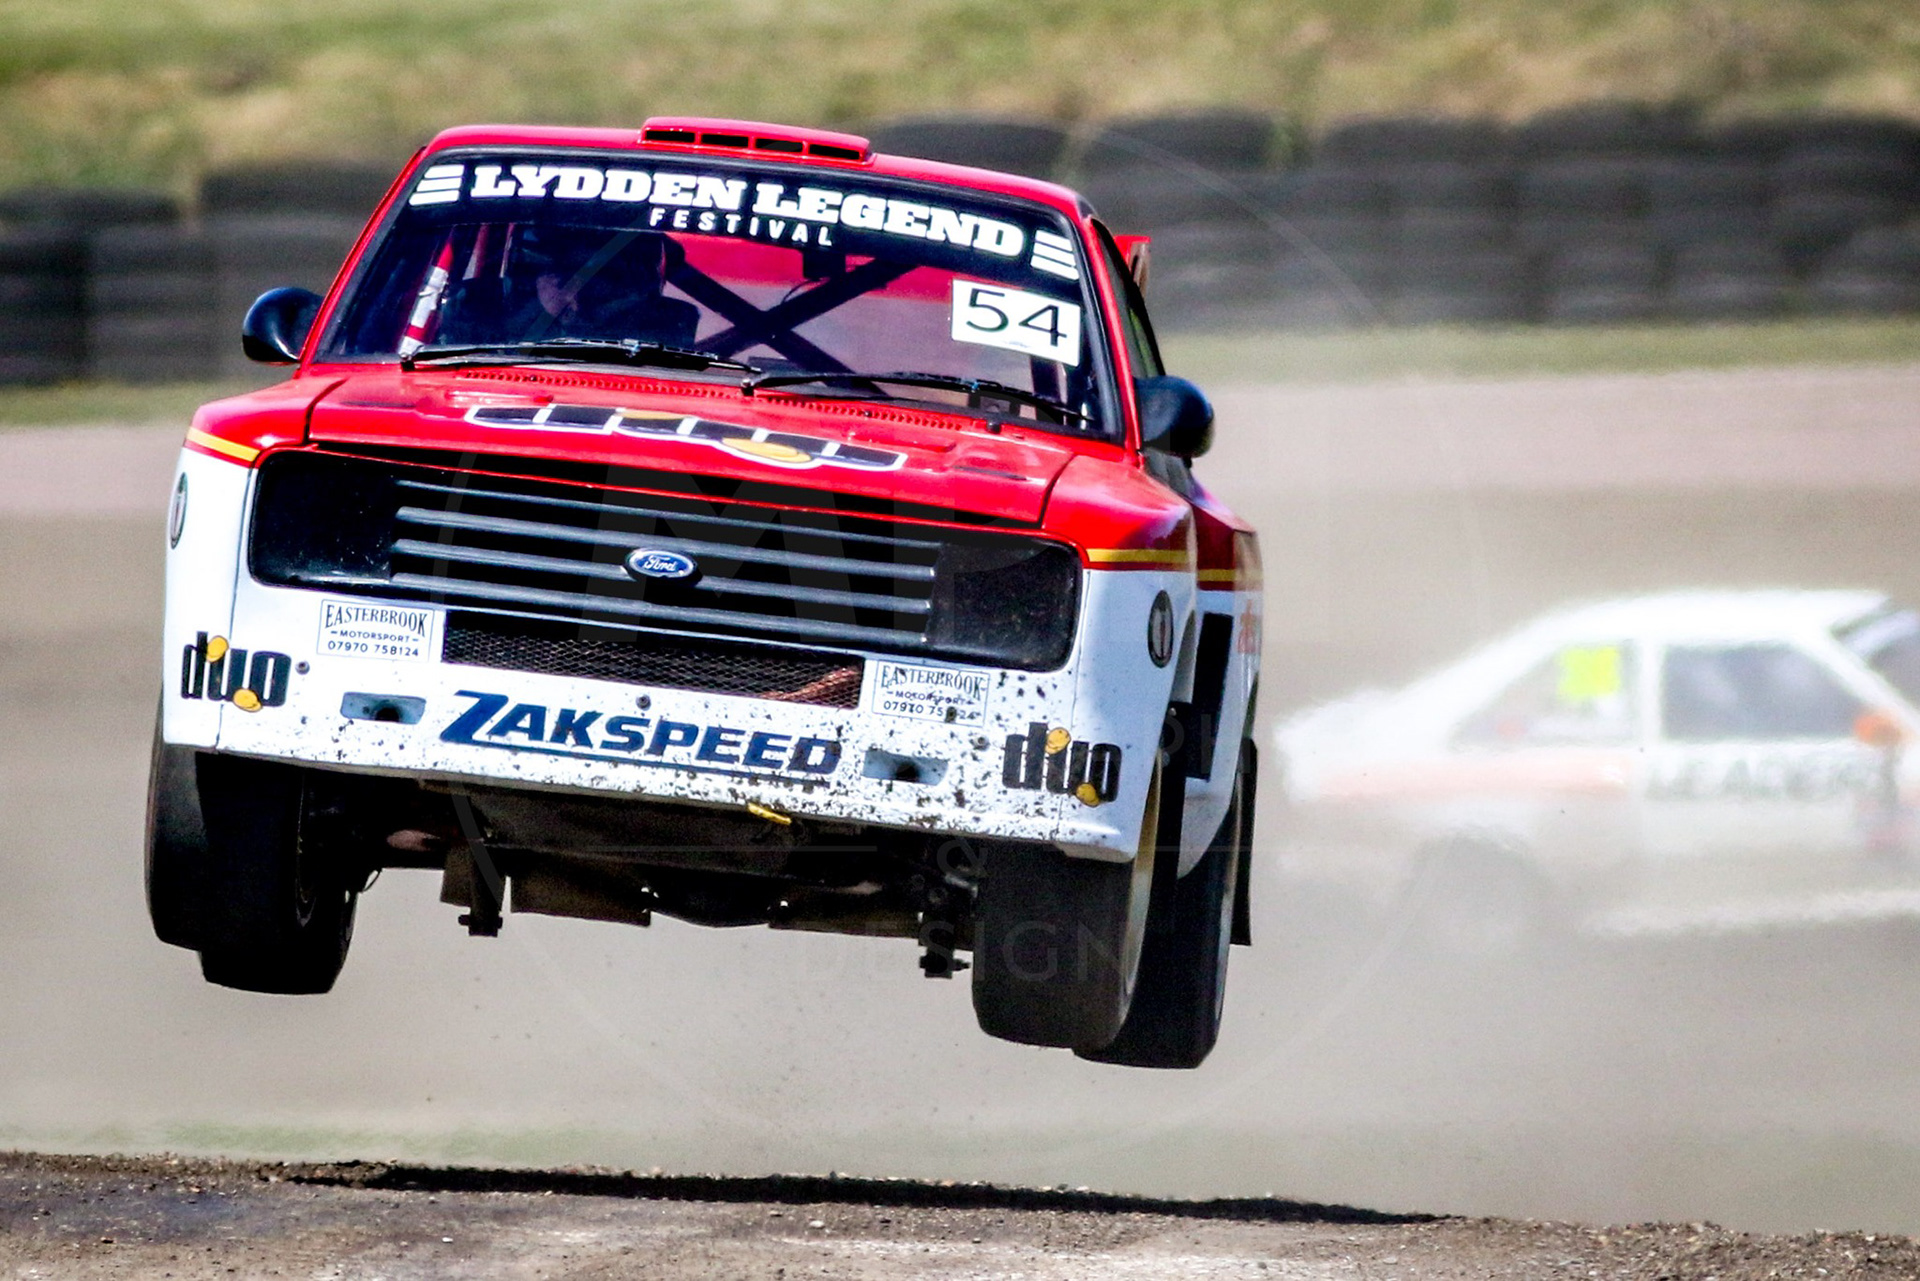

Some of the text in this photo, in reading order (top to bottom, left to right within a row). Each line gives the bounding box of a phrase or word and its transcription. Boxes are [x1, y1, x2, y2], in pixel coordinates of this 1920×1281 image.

[470, 165, 1024, 257] LYDDEN LEGEND
[649, 207, 833, 248] FESTIVAL
[965, 287, 1068, 348] 54
[643, 554, 679, 572] Ford
[325, 604, 428, 638] EASTERBROOK
[339, 630, 410, 643] MOTORSPORT
[327, 640, 419, 657] 07970 758124
[881, 665, 984, 701] EASTERBROOK
[440, 689, 842, 775] ZAKSPEED
